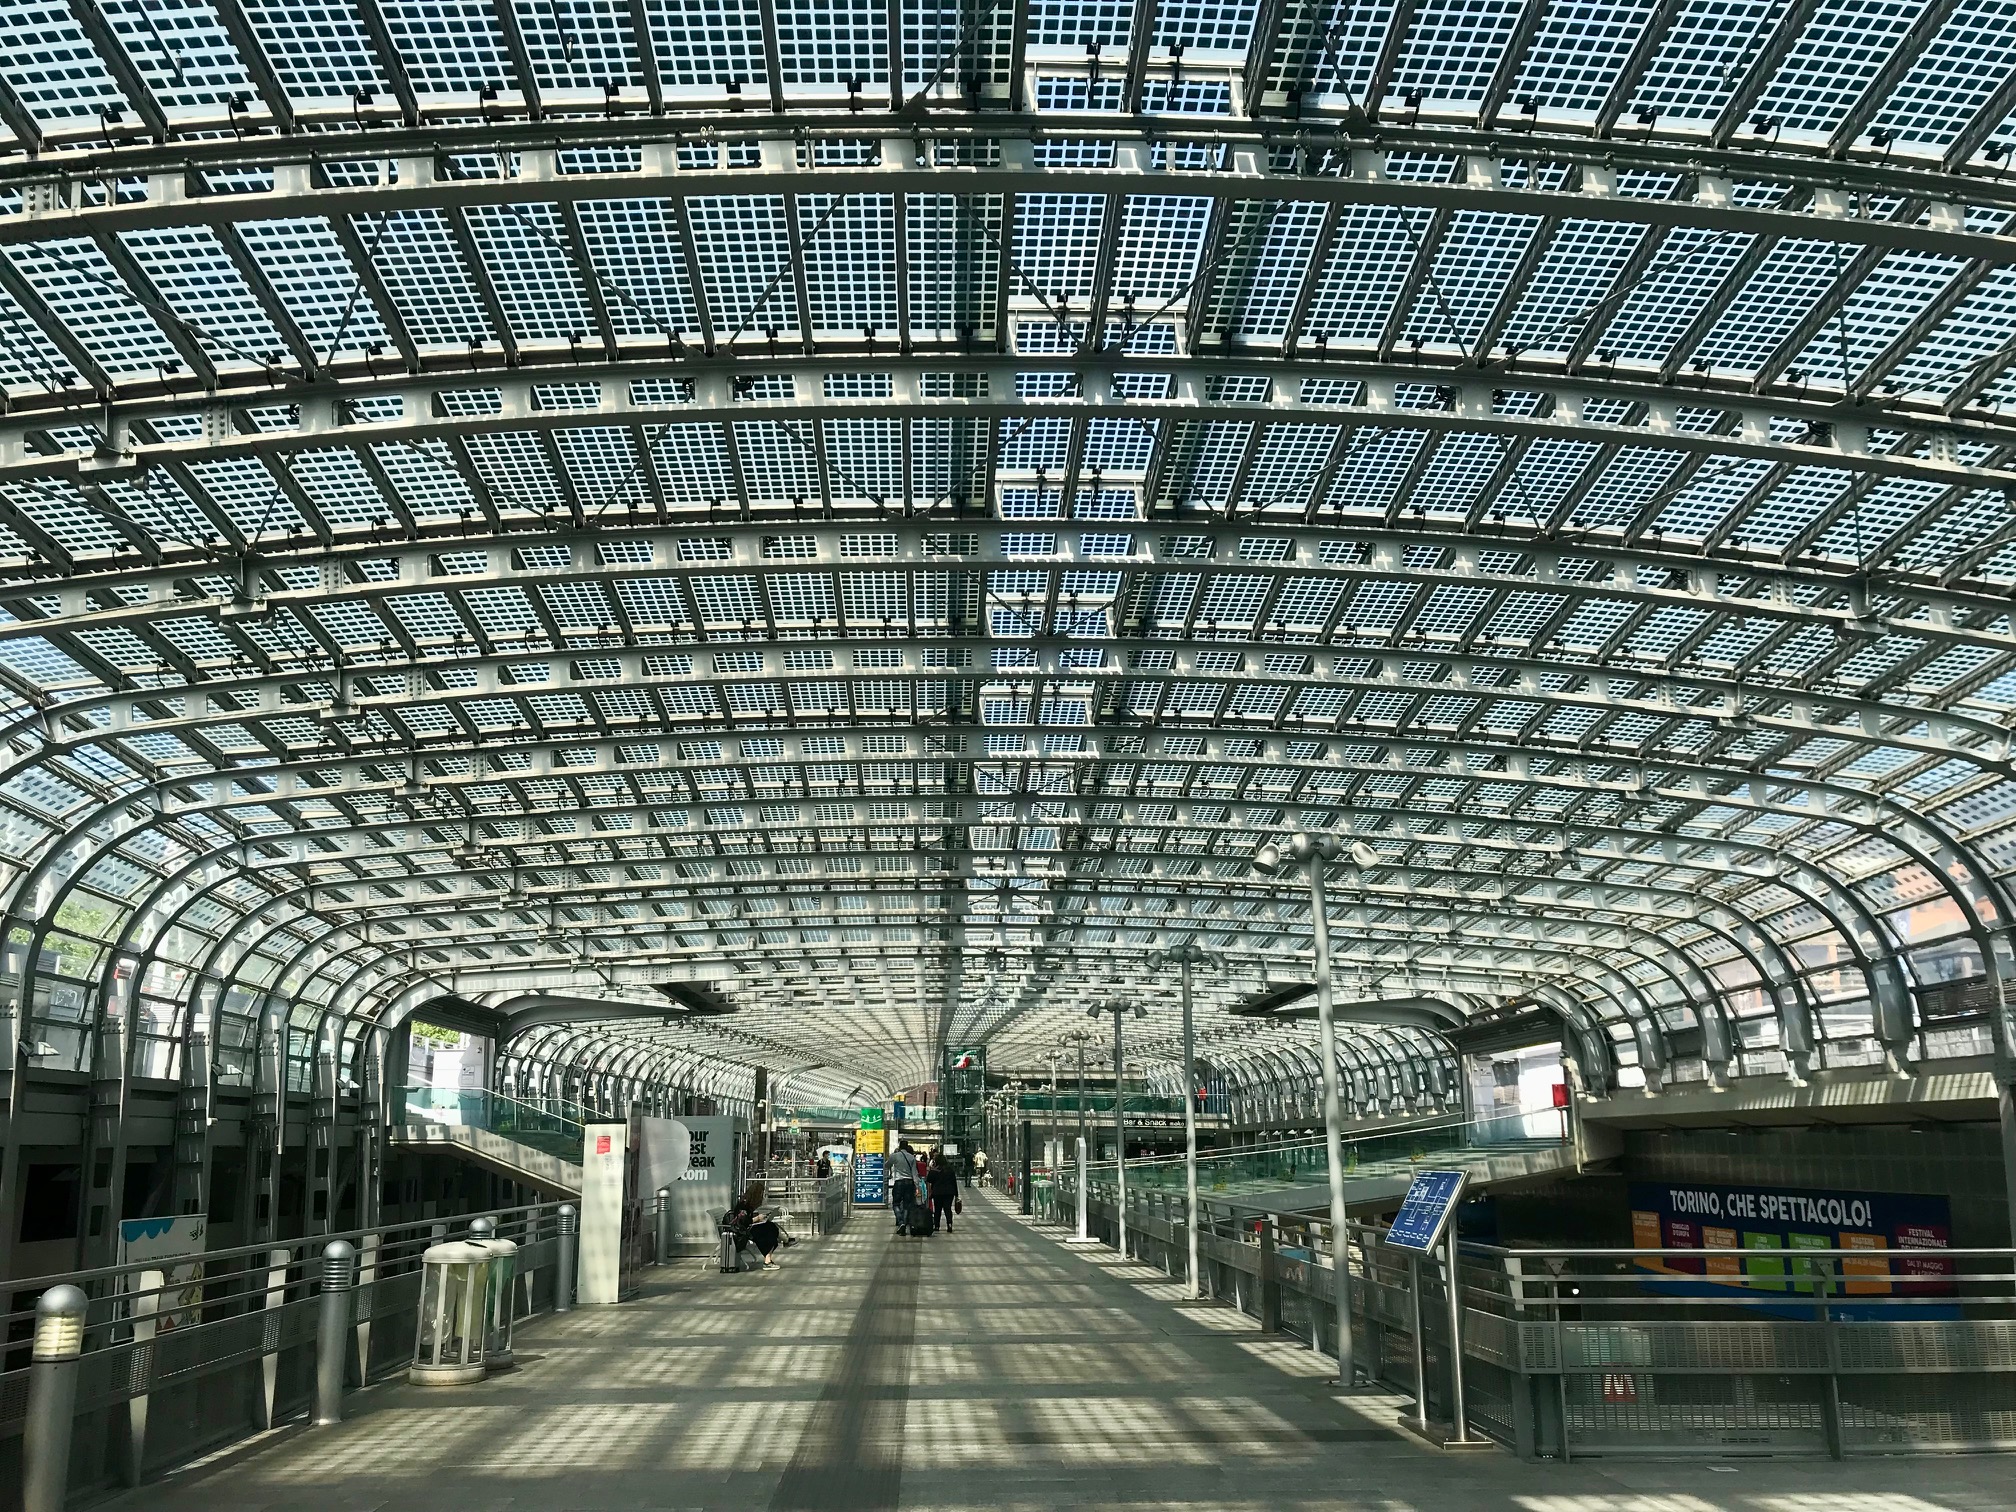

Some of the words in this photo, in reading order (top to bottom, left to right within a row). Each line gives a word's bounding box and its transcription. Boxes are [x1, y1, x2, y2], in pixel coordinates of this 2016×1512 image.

[688, 1131, 709, 1142] our
[689, 1143, 707, 1155] est
[1669, 1189, 1725, 1219] TORINO,
[1726, 1193, 1756, 1218] CHE
[1759, 1194, 1873, 1228] SPETTACOLO!
[1908, 1228, 1935, 1238] FESTIVAL
[1898, 1236, 1948, 1248] INTERNAZIONALE
[1922, 1261, 1944, 1271] MAGGIO
